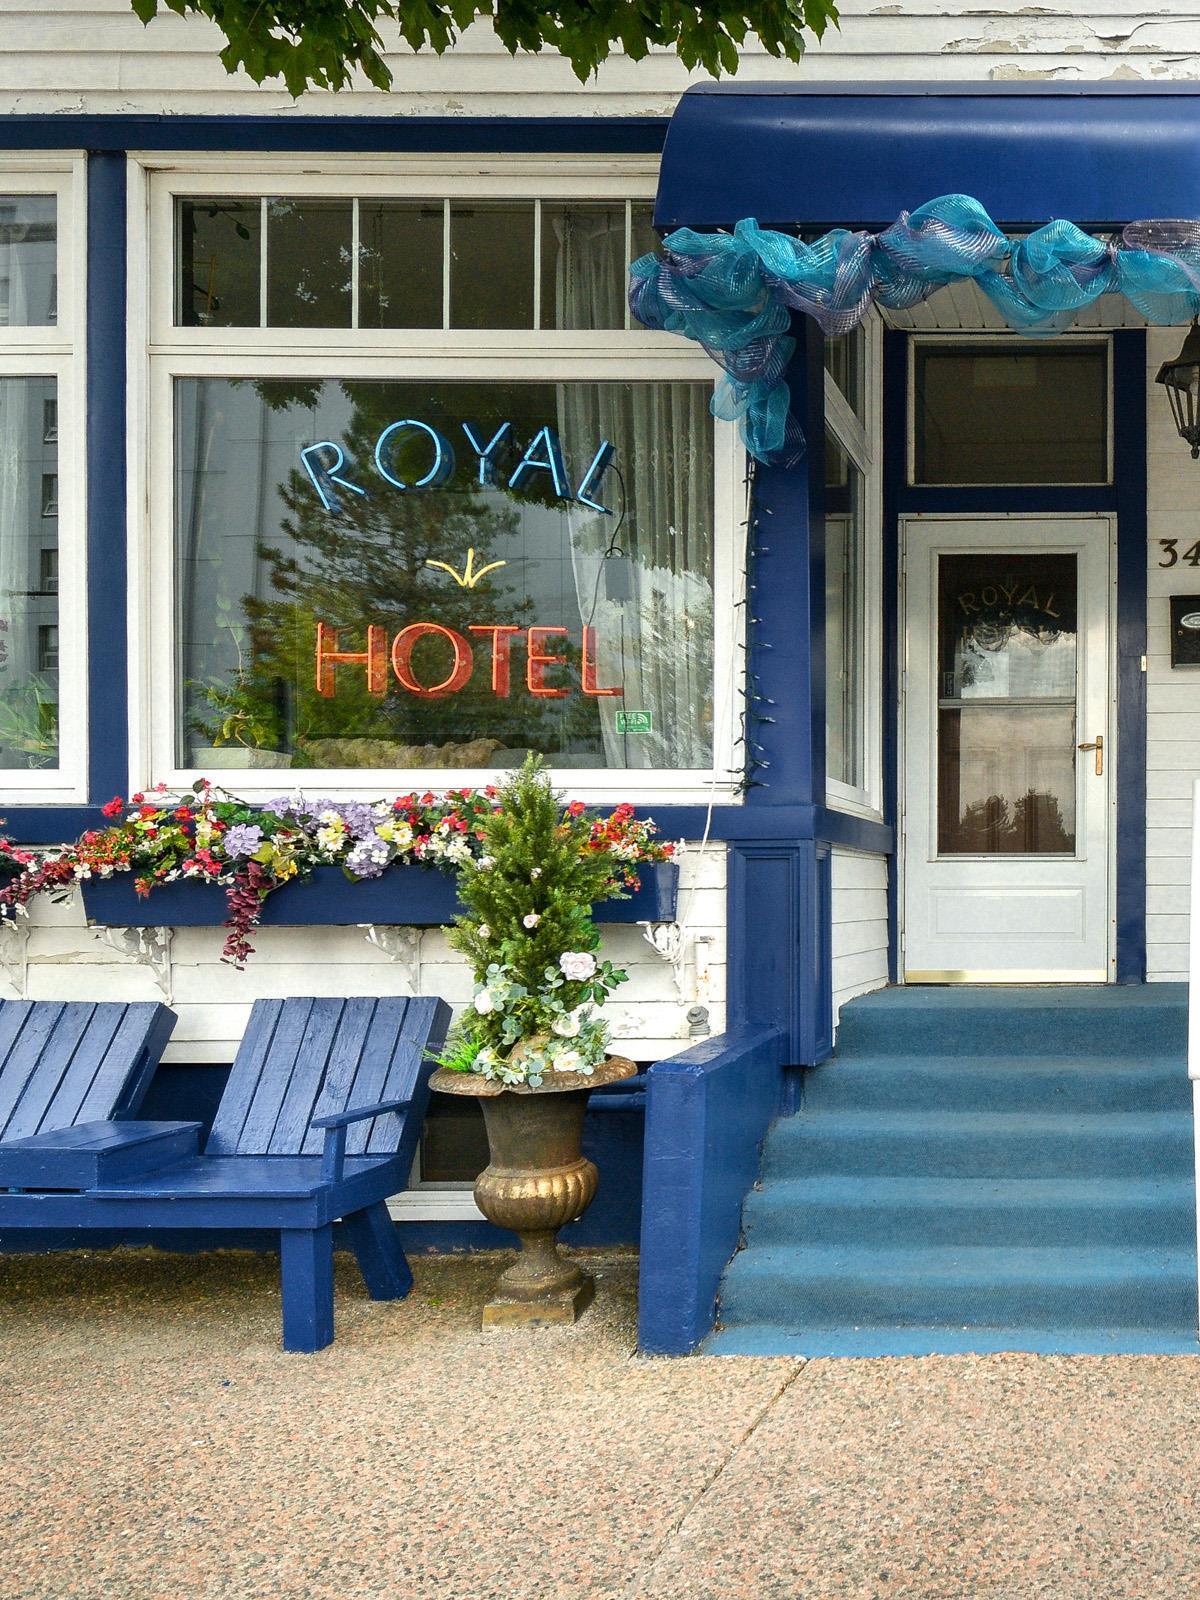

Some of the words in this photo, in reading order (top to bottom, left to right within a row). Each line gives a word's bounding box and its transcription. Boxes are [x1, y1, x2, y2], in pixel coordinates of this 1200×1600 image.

[301, 419, 612, 515] ROYAL
[958, 584, 1061, 618] ROYAL
[316, 622, 624, 698] HOTEL
